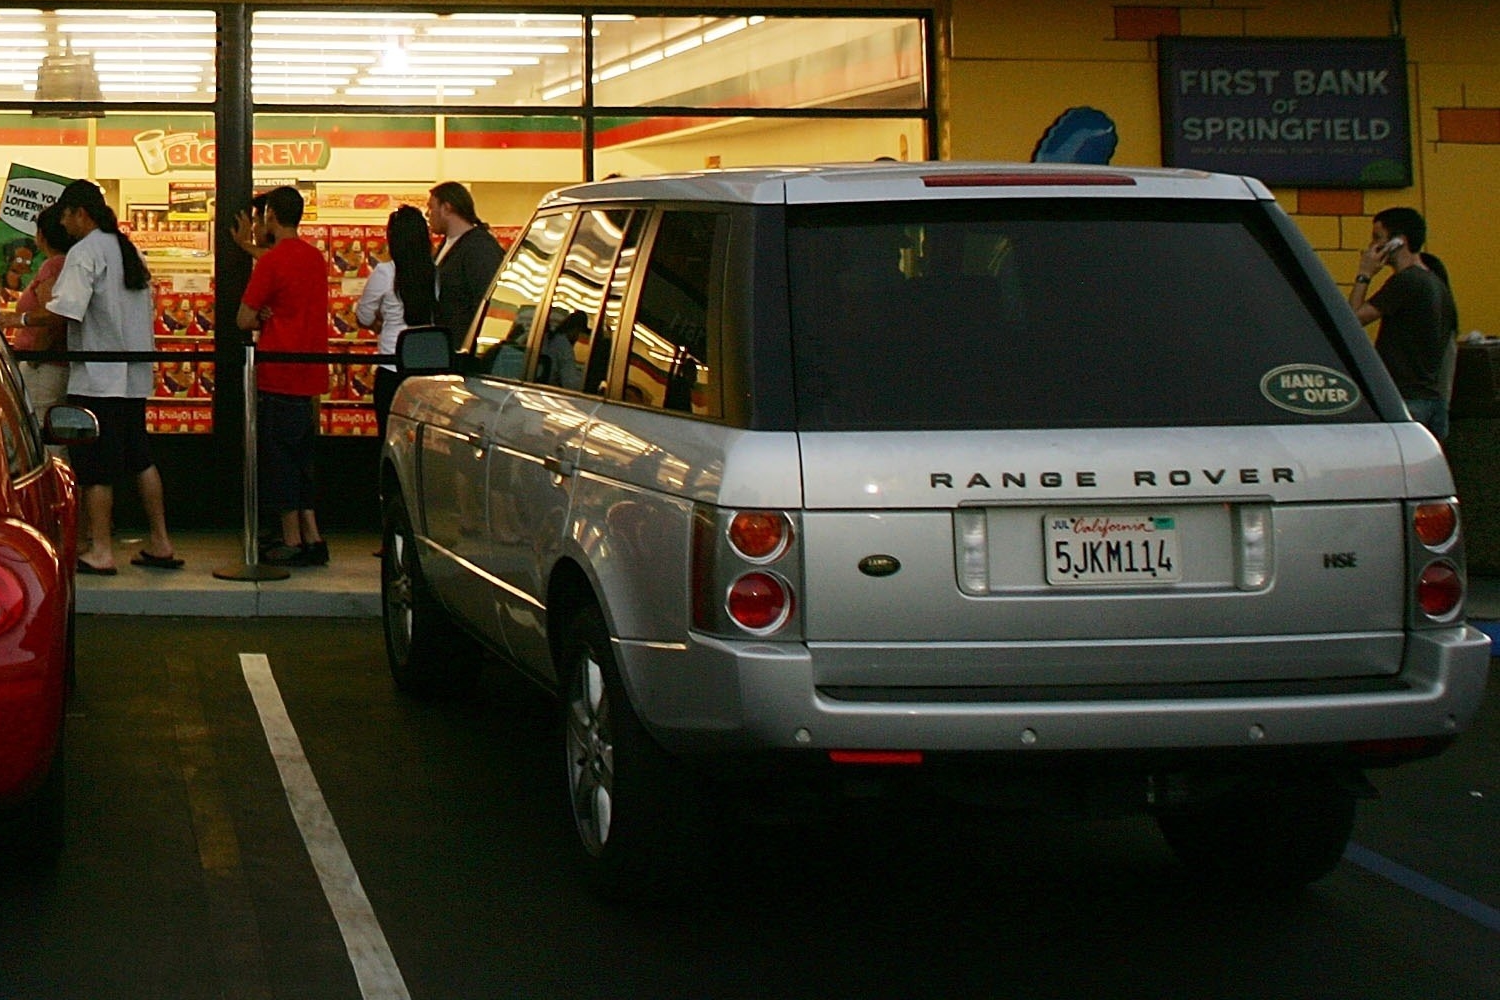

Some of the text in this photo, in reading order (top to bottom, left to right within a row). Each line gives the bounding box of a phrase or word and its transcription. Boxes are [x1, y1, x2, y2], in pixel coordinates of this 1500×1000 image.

[1179, 69, 1389, 95] FIRST BANK
[1271, 98, 1300, 114] OF
[1182, 117, 1391, 141] SPRINGFIELD
[252, 142, 323, 165] REW
[8, 183, 39, 200] THANK
[2, 206, 30, 221] COME
[1281, 374, 1326, 388] HANG
[1303, 388, 1349, 403] OVER
[930, 466, 1297, 489] RANGE ROVER
[1052, 519, 1070, 530] JUL
[1073, 516, 1155, 538] California
[1055, 539, 1172, 574] 5JKM114
[1323, 552, 1357, 568] HSE
